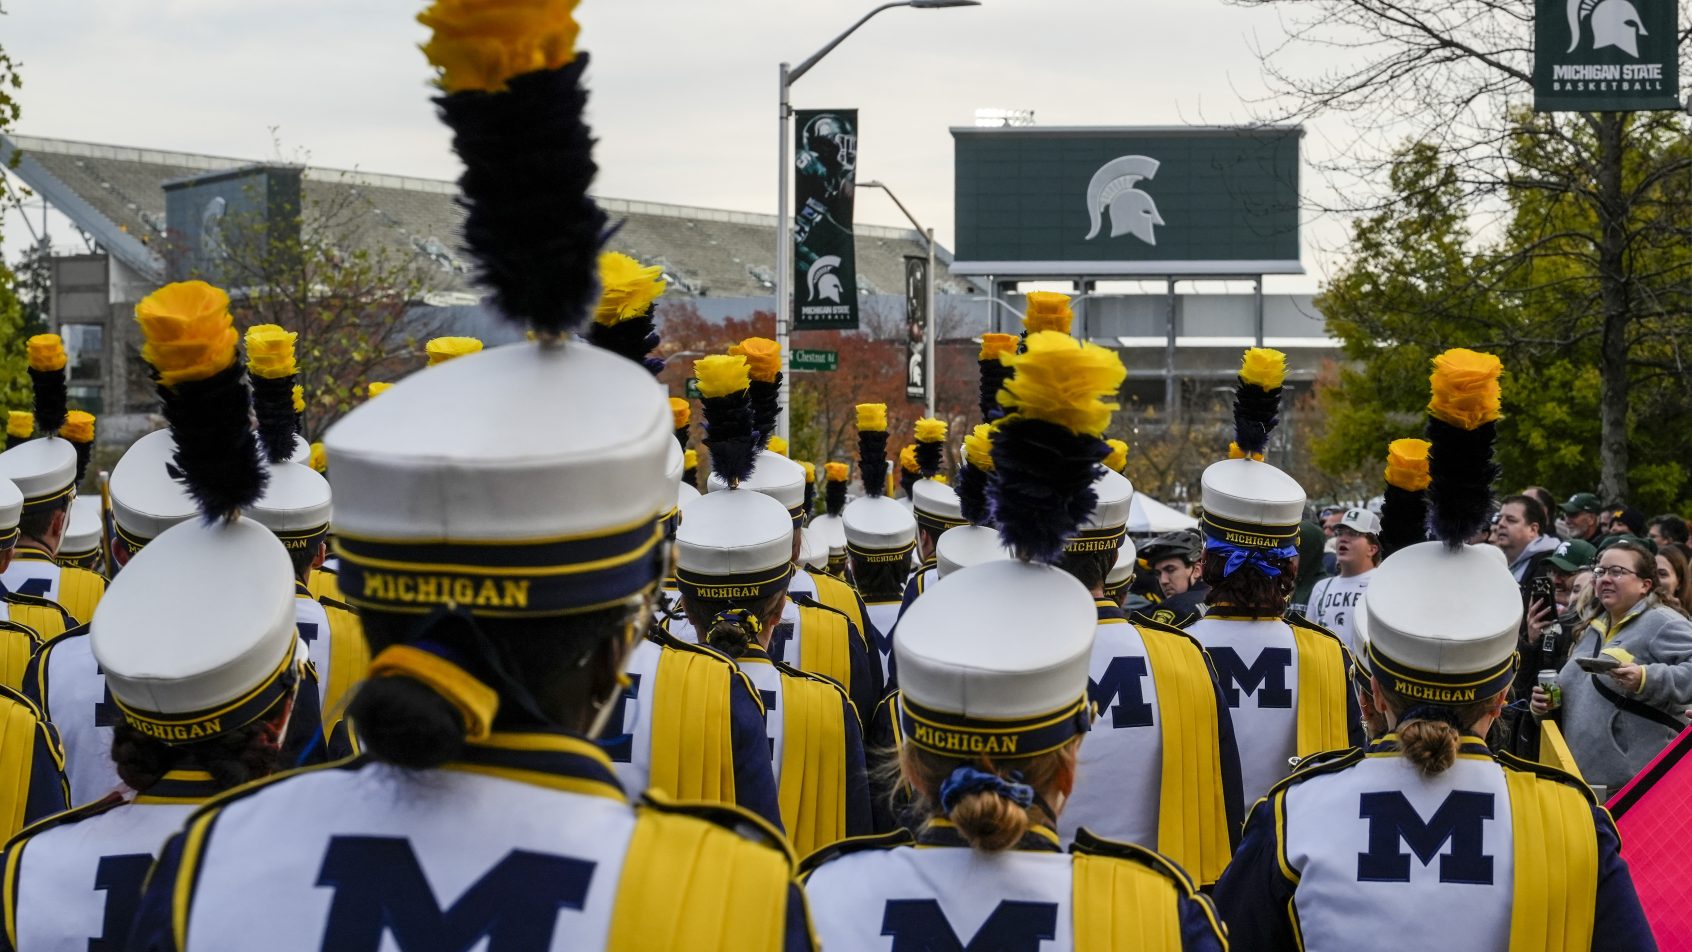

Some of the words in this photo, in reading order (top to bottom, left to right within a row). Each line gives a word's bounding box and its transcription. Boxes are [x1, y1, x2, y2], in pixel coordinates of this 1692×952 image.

[1553, 64, 1620, 80] MICHIGAN
[1623, 63, 1663, 80] STATE
[1553, 81, 1662, 91] BASKETBALL
[796, 350, 826, 363] Chestnut
[1062, 538, 1118, 552] MICHIGAN
[1226, 532, 1279, 547] MICHIGAN
[867, 554, 904, 563] MICHIGAN
[363, 571, 529, 608] MICHIGAN
[696, 586, 760, 598] MICHIGAN
[1205, 647, 1292, 708] M
[1088, 656, 1154, 731] M
[1395, 680, 1477, 701] MICHIGAN
[126, 713, 222, 740] MICHIGAN
[914, 723, 1018, 753] MICHIGAN
[1357, 790, 1495, 885] M
[313, 834, 598, 952] M
